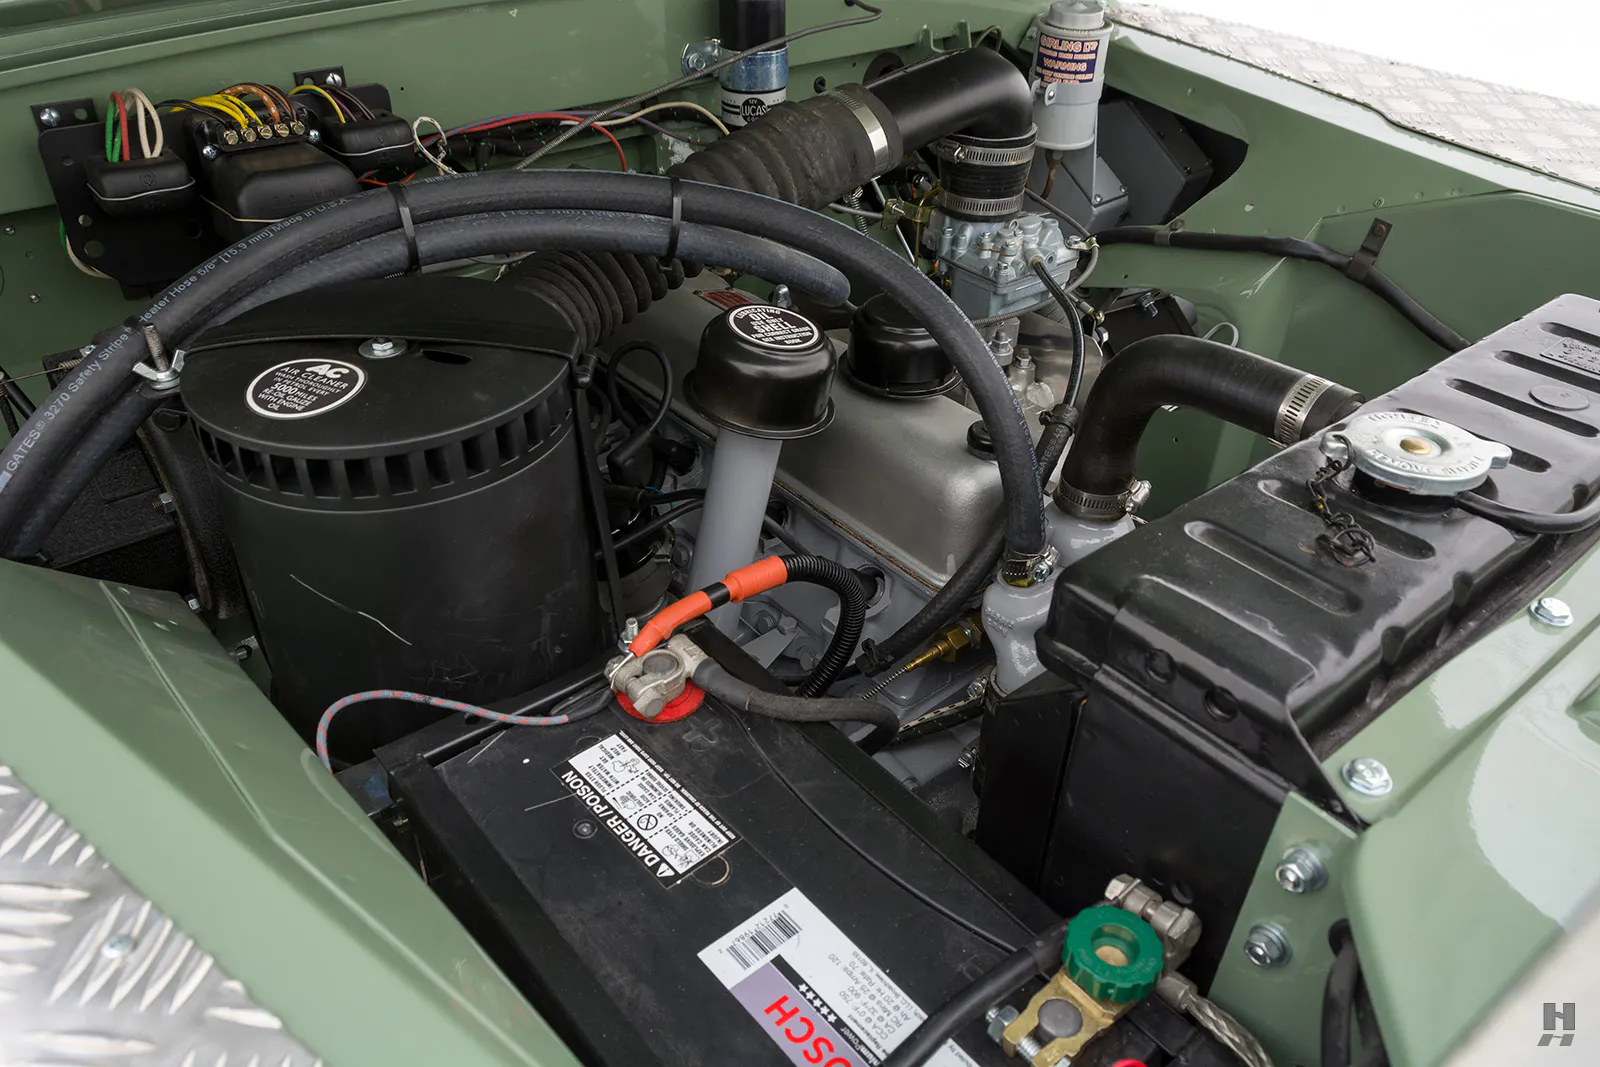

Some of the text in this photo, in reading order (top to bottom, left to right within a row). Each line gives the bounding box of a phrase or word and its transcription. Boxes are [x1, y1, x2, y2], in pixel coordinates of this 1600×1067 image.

[1043, 57, 1087, 72] WARNING
[741, 104, 768, 116] LUCAS
[43, 390, 70, 420] 3270
[67, 358, 102, 393] Safety
[169, 273, 197, 298] Hose
[248, 227, 273, 245] mm]
[271, 214, 303, 233] Made
[302, 208, 315, 218] in
[749, 312, 774, 321] OIL
[753, 322, 796, 333] SHELL
[280, 367, 349, 389] AIR CLEANER
[305, 363, 349, 379] AC
[271, 382, 319, 401] 5000 MILES
[281, 379, 307, 390] PETROL
[308, 387, 330, 396] EVERY
[294, 376, 341, 394] THOROUGHLY
[257, 393, 305, 411] WITH ENGINE
[267, 403, 281, 411] OIL
[286, 395, 312, 407] GAUZE
[598, 744, 614, 760] MEDICAL
[610, 746, 621, 756] HELP
[616, 742, 627, 752] FAST
[599, 755, 608, 763] GET
[587, 764, 613, 789] IMMEDIATELY
[596, 762, 619, 784] WITH WATER
[663, 798, 679, 814] FLAMES
[671, 825, 705, 857] EXPLOSIVE GASES
[687, 830, 711, 852] CAN CAUSE
[694, 827, 717, 848] BLINDNESS
[706, 829, 723, 844] INJURY
[827, 952, 842, 966] 120
[848, 960, 859, 971] 70
[838, 990, 852, 1003] 750
[846, 985, 861, 999] 900
[858, 984, 869, 995] 25
[882, 994, 894, 1005] 20
[874, 1000, 892, 1017] Mins
[898, 1010, 910, 1021] Ah
[882, 1021, 895, 1034] CA
[890, 1015, 903, 1028] RC
[763, 993, 853, 1066] SCH
[847, 1013, 882, 1049] Replacement
[870, 1022, 888, 1040] CCA
